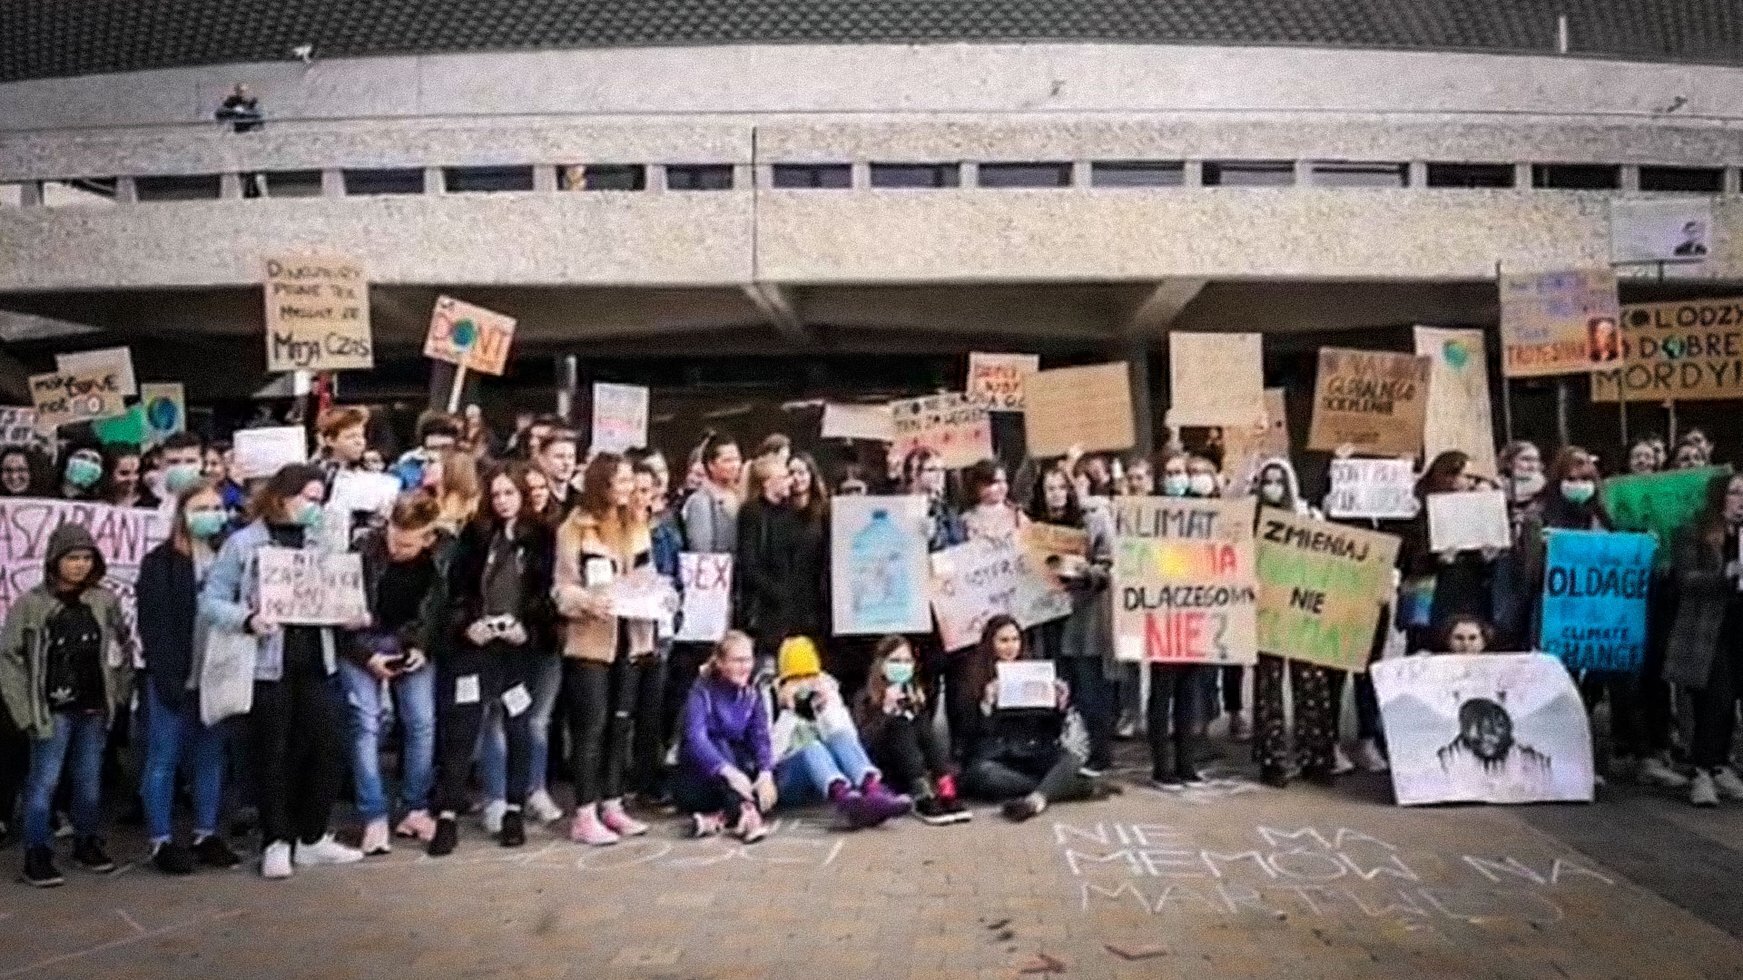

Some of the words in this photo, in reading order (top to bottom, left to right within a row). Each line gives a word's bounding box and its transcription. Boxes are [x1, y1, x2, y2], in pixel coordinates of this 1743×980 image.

[1263, 520, 1370, 562] ZMIENIAJ
[1289, 586, 1326, 614] NIE
[1053, 823, 1182, 847] NIE
[1256, 825, 1398, 850] MA
[1461, 855, 1615, 884] NA
